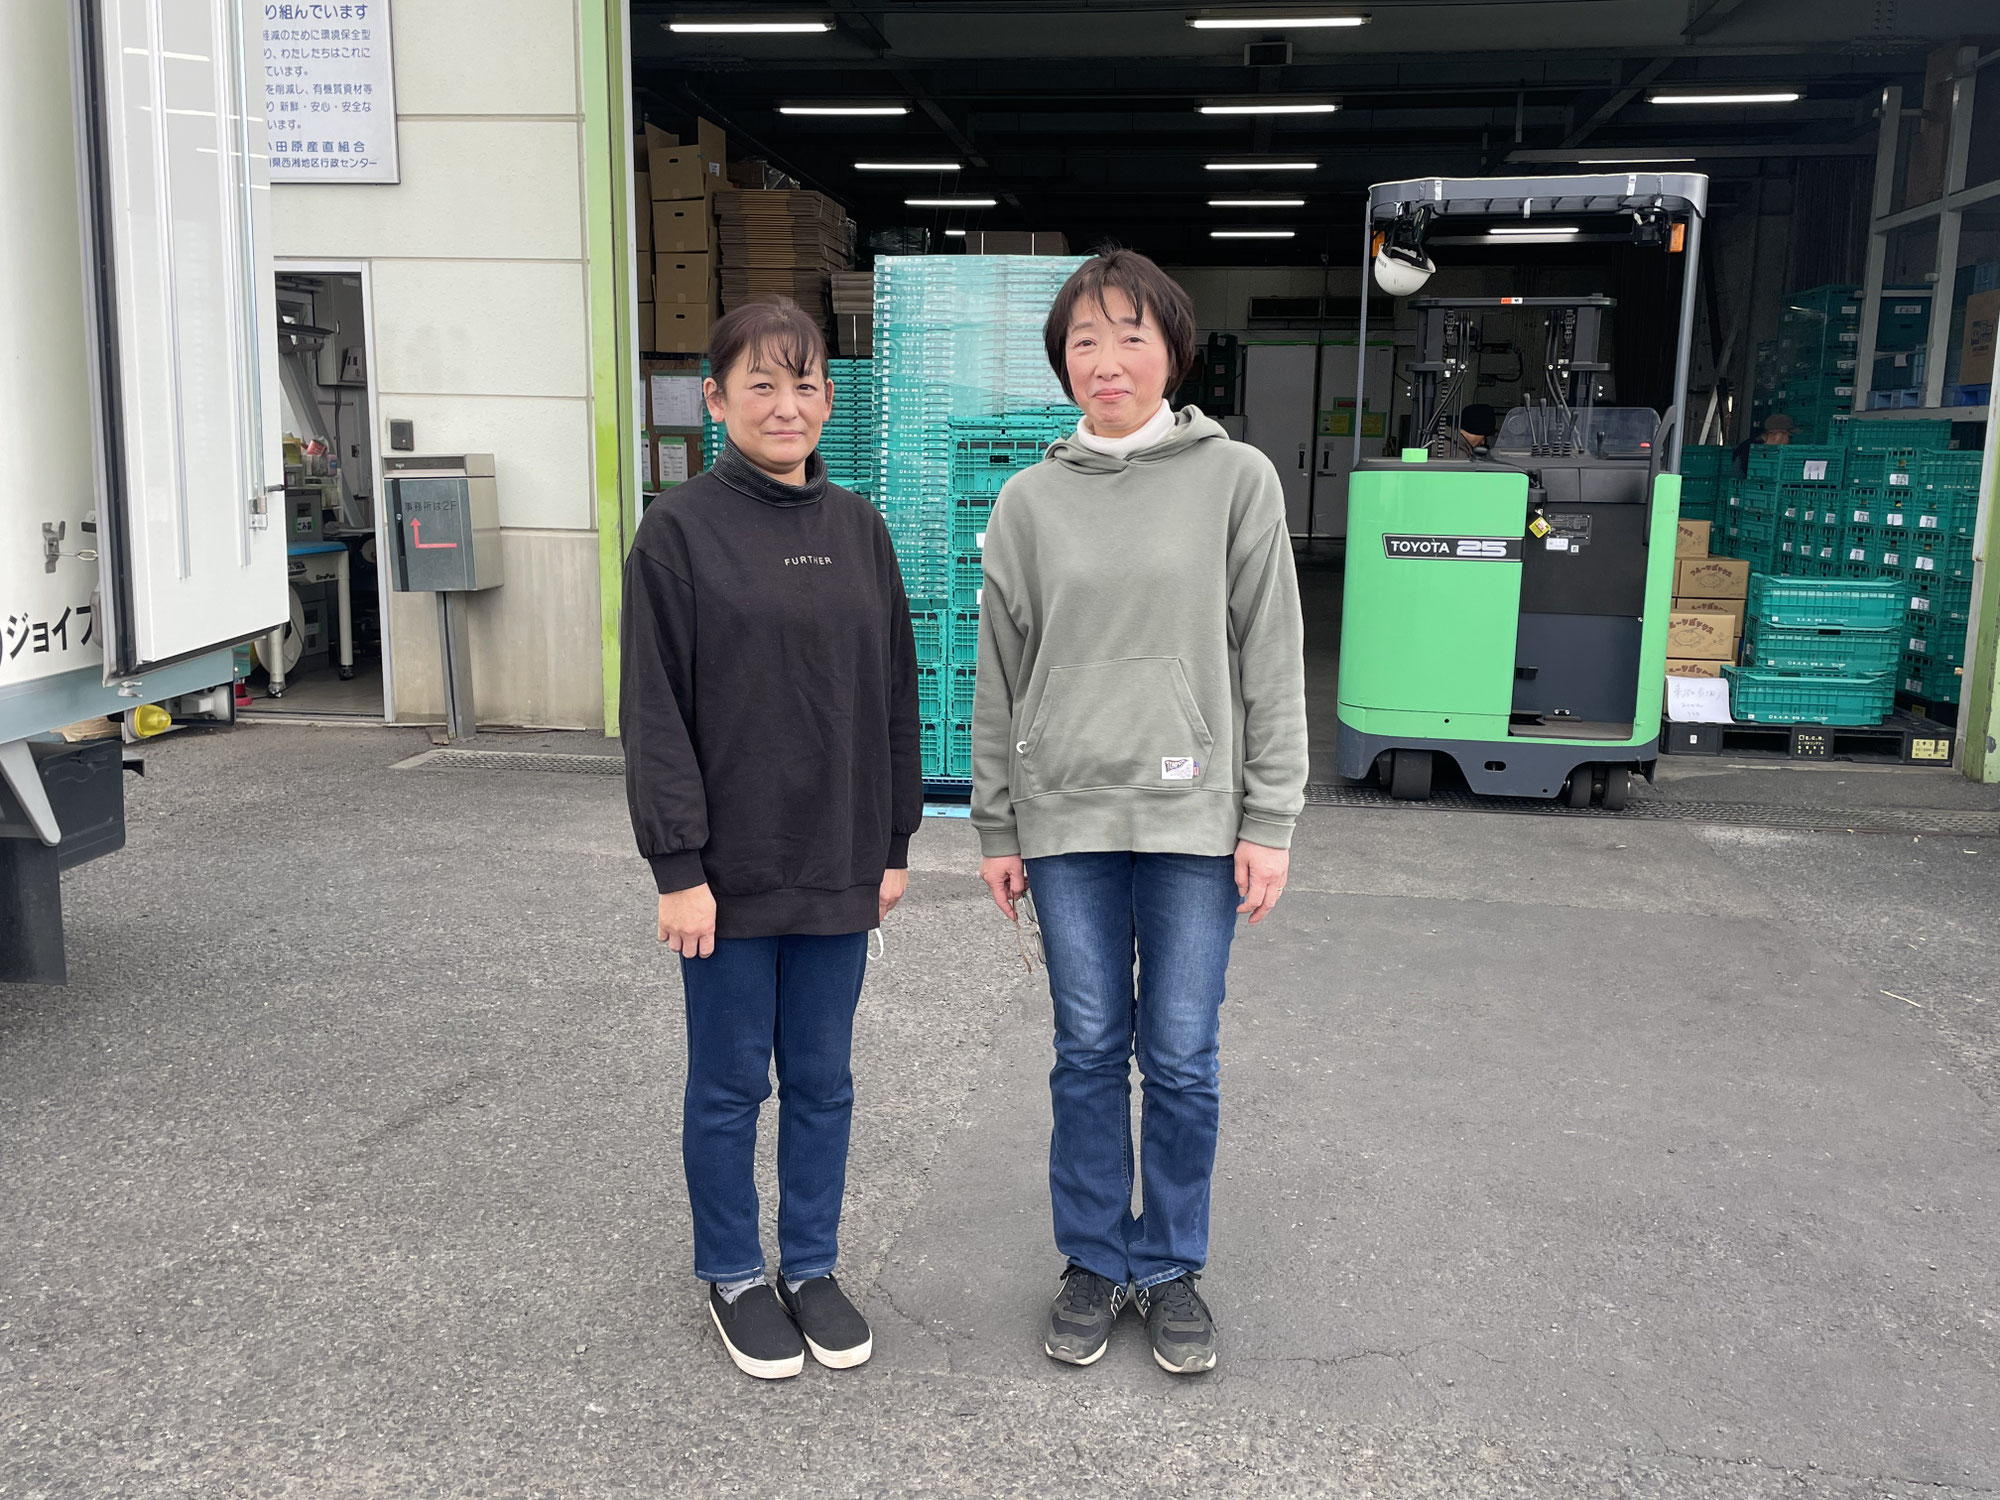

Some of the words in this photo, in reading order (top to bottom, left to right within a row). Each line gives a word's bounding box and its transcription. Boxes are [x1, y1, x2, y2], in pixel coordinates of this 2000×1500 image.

[265, 4, 368, 20] り組んでいます
[269, 157, 377, 169] 県西湘地区行政センター
[1390, 540, 1450, 554] TOYOTA
[1456, 540, 1508, 557] 25
[784, 555, 833, 567] FURTHER
